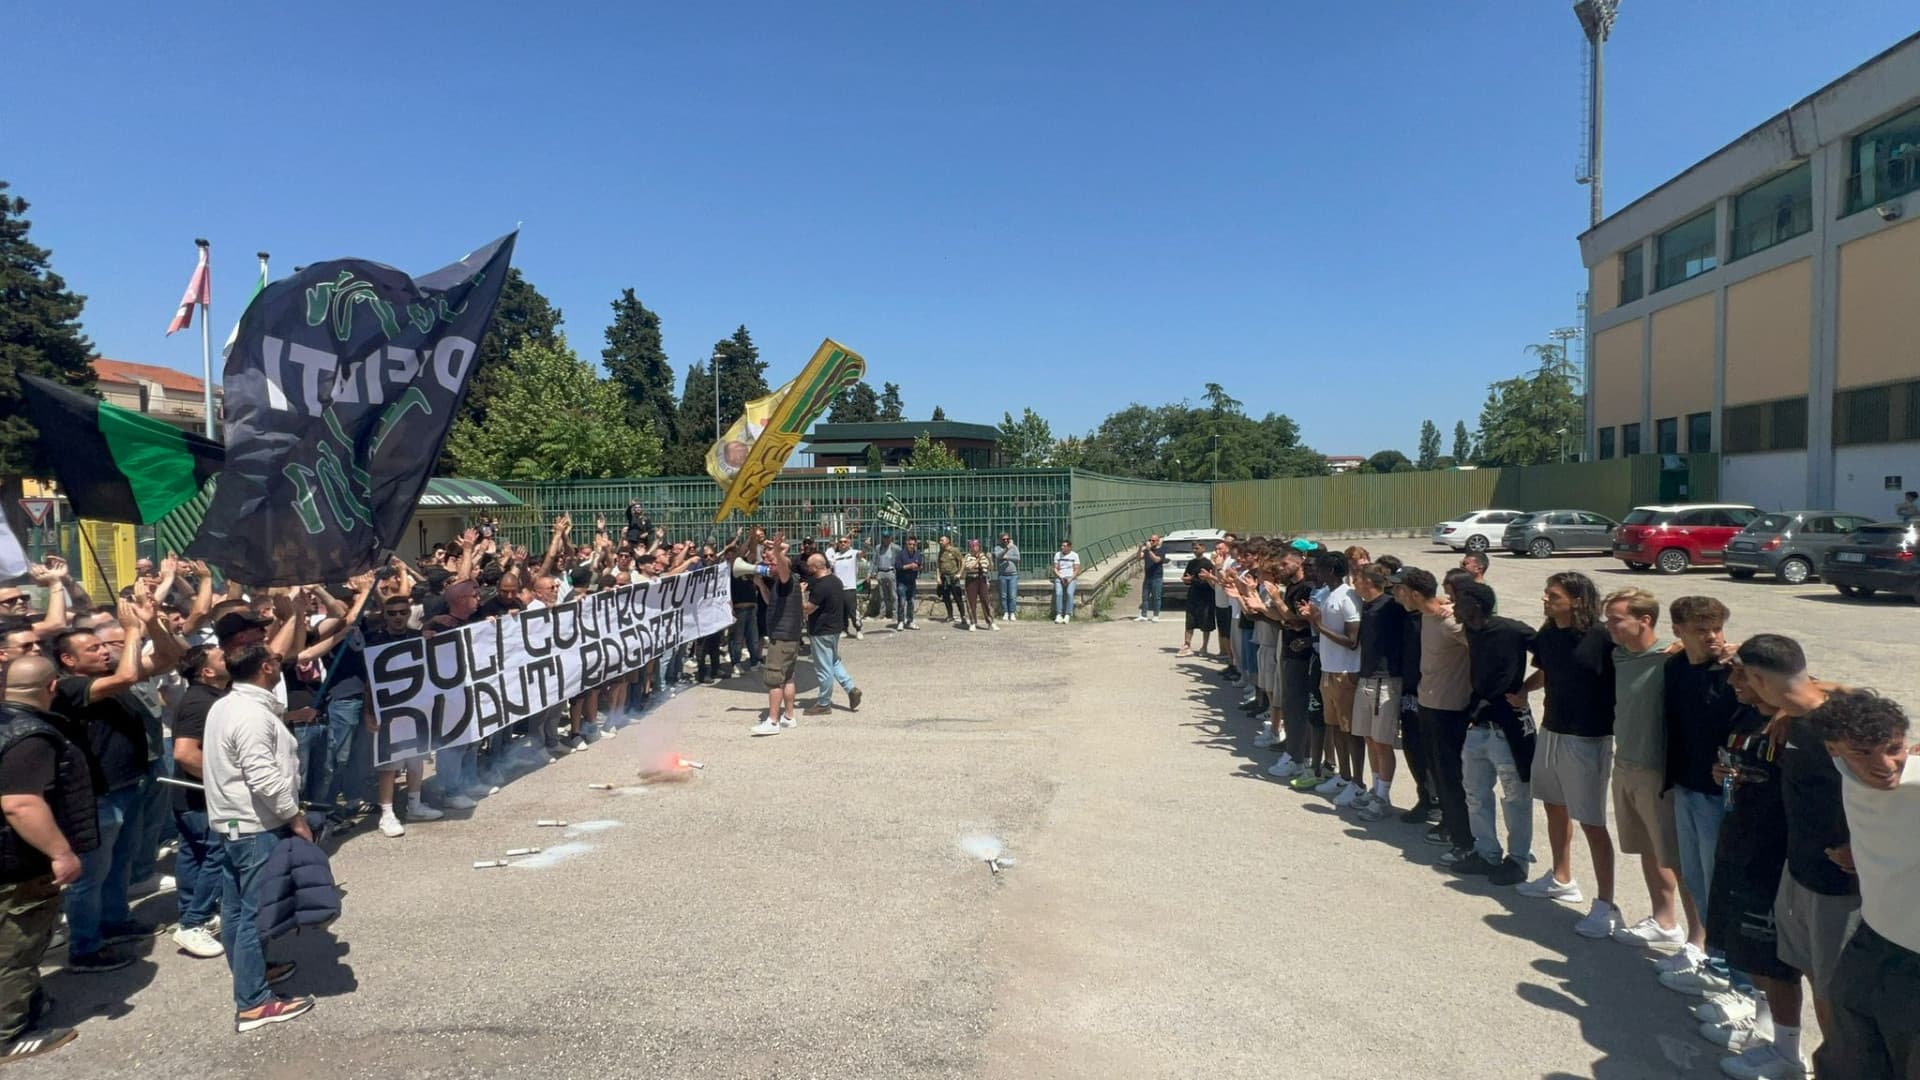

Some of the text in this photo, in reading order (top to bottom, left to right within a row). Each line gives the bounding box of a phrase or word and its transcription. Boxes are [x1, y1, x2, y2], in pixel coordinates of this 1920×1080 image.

[373, 565, 718, 708] SOLI CONTRO TUTTI
[377, 608, 684, 763] AVANTI RAGAZZI!
